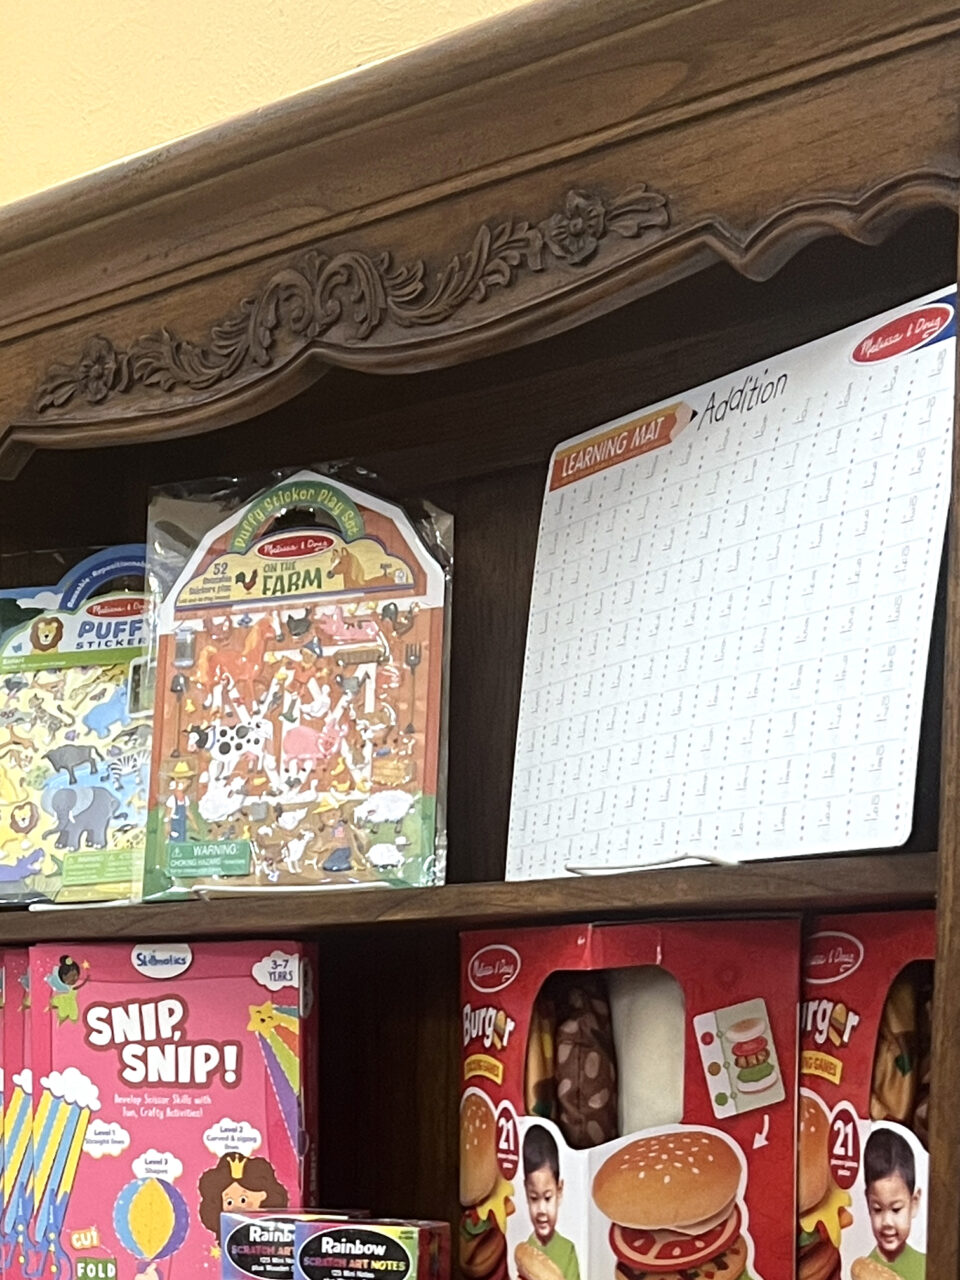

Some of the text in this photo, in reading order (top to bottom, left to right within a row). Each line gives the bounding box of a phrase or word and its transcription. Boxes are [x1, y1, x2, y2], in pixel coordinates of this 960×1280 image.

[860, 330, 902, 357] Melissa
[914, 316, 941, 339] Doug
[697, 369, 787, 431] Addition
[562, 417, 664, 477] LEARNING MAT
[214, 562, 227, 575] 52
[262, 568, 322, 595] FARM
[267, 971, 293, 982] YEARS
[87, 999, 184, 1046] SNIP,
[122, 1044, 238, 1083] SNIP!
[498, 1118, 514, 1150] 21
[833, 1120, 853, 1157] 21
[70, 1228, 99, 1249] CUT
[321, 1237, 386, 1256] Rainbow
[76, 1263, 116, 1278] FOLD
[304, 1257, 406, 1271] SCRATCH ART NOTES
